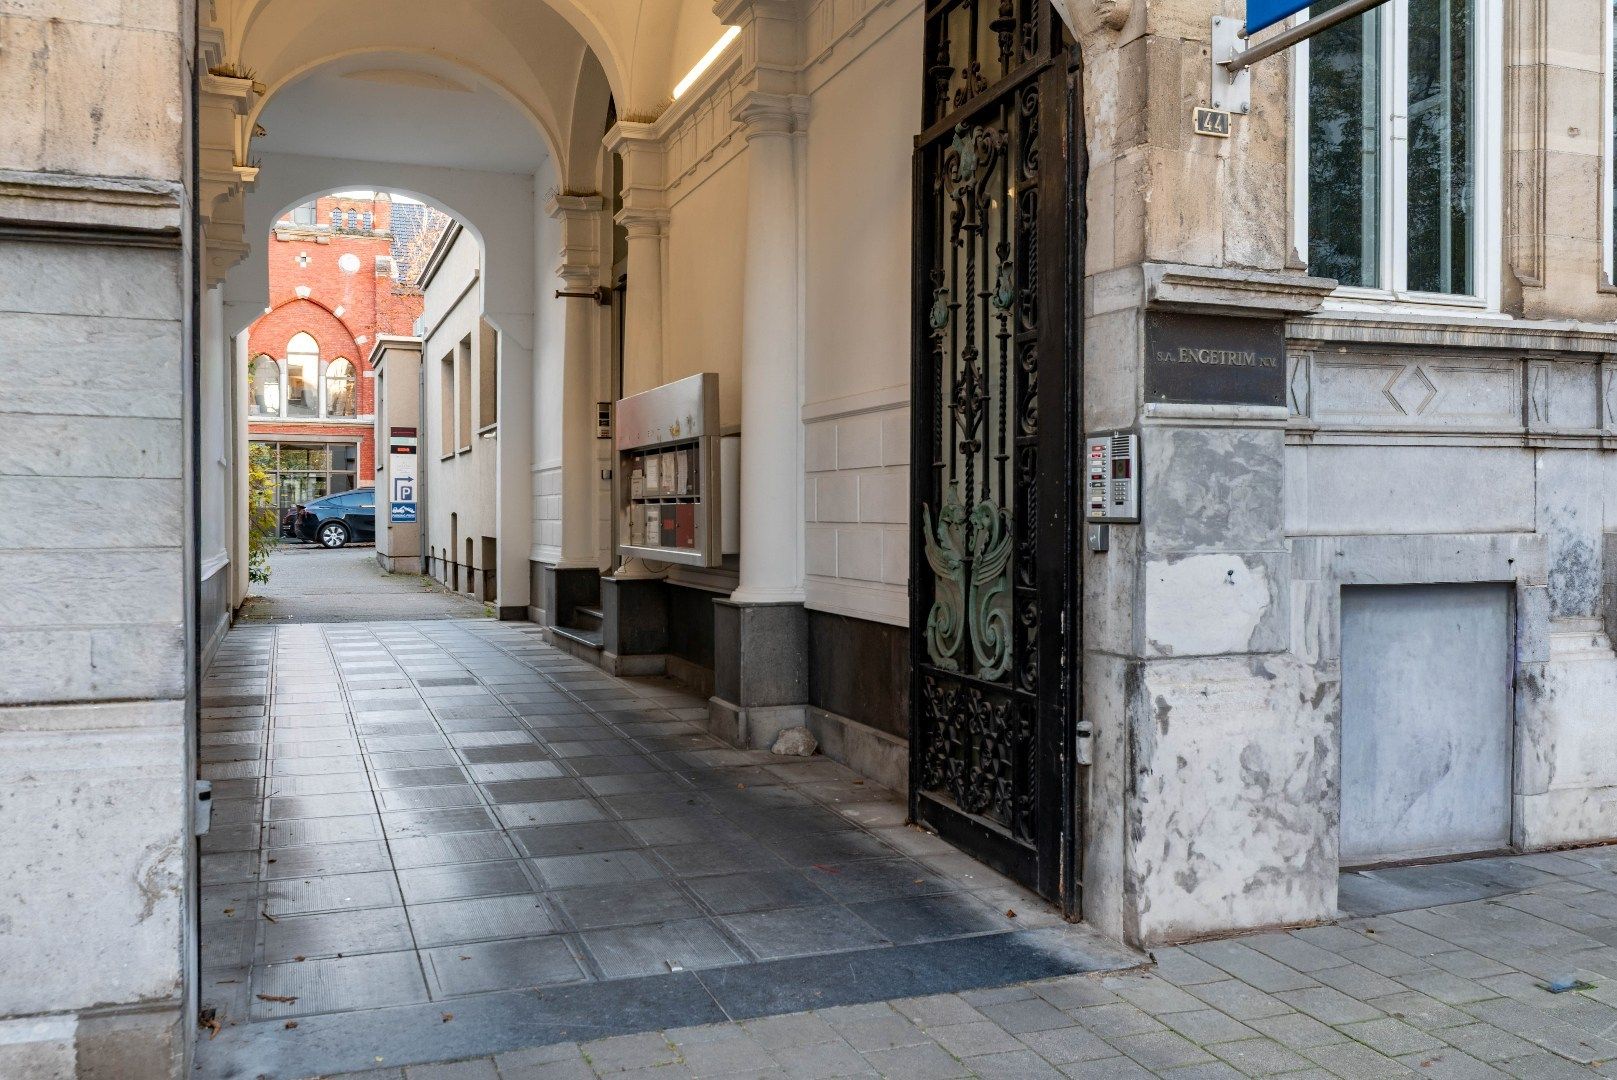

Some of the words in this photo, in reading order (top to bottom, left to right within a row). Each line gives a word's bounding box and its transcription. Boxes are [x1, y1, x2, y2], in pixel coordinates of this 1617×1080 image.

[1203, 112, 1222, 132] 44
[1178, 347, 1256, 367] ENGETRIM
[402, 487, 411, 500] P
